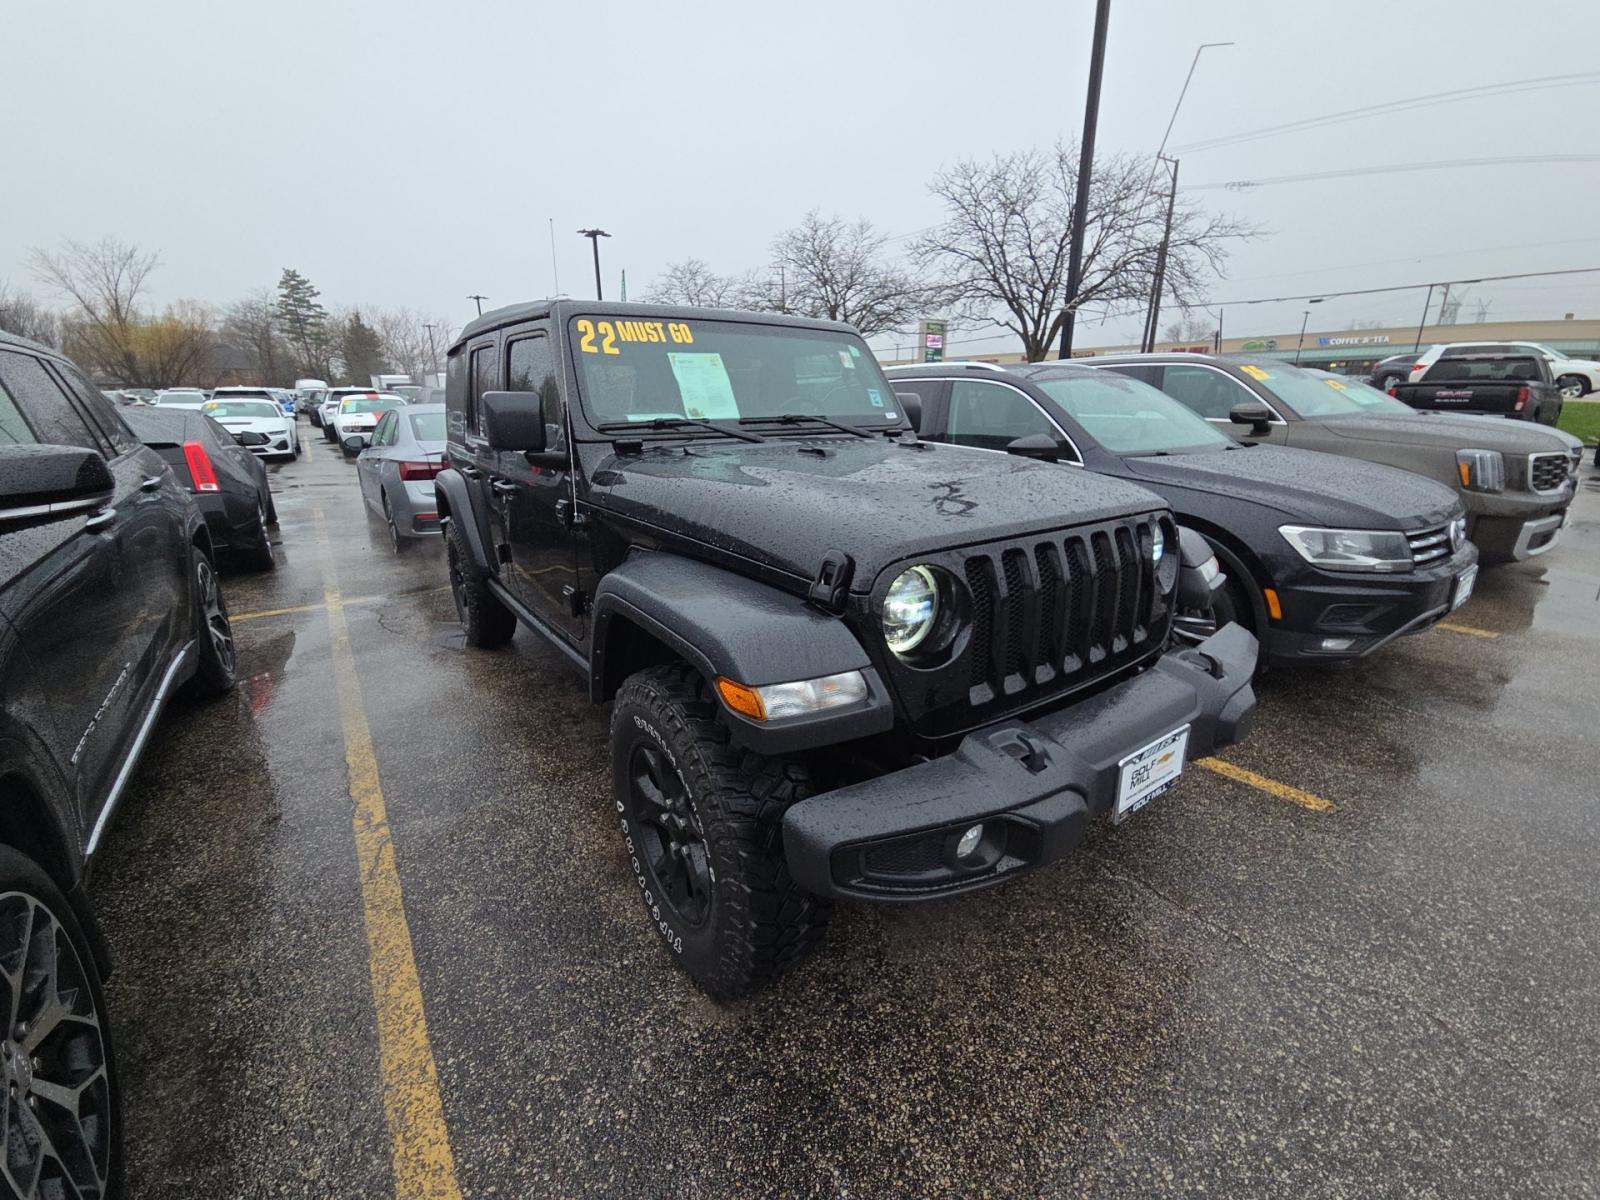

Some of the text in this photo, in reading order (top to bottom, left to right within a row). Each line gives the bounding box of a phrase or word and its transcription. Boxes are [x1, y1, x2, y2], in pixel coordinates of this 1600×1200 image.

[577, 320, 693, 354] 22 MUST GO
[1329, 336, 1360, 345] COFFEE
[1374, 335, 1390, 343] TEA
[1435, 390, 1474, 398] GMC
[1131, 759, 1157, 780] GOLF
[1130, 771, 1150, 790] MILL
